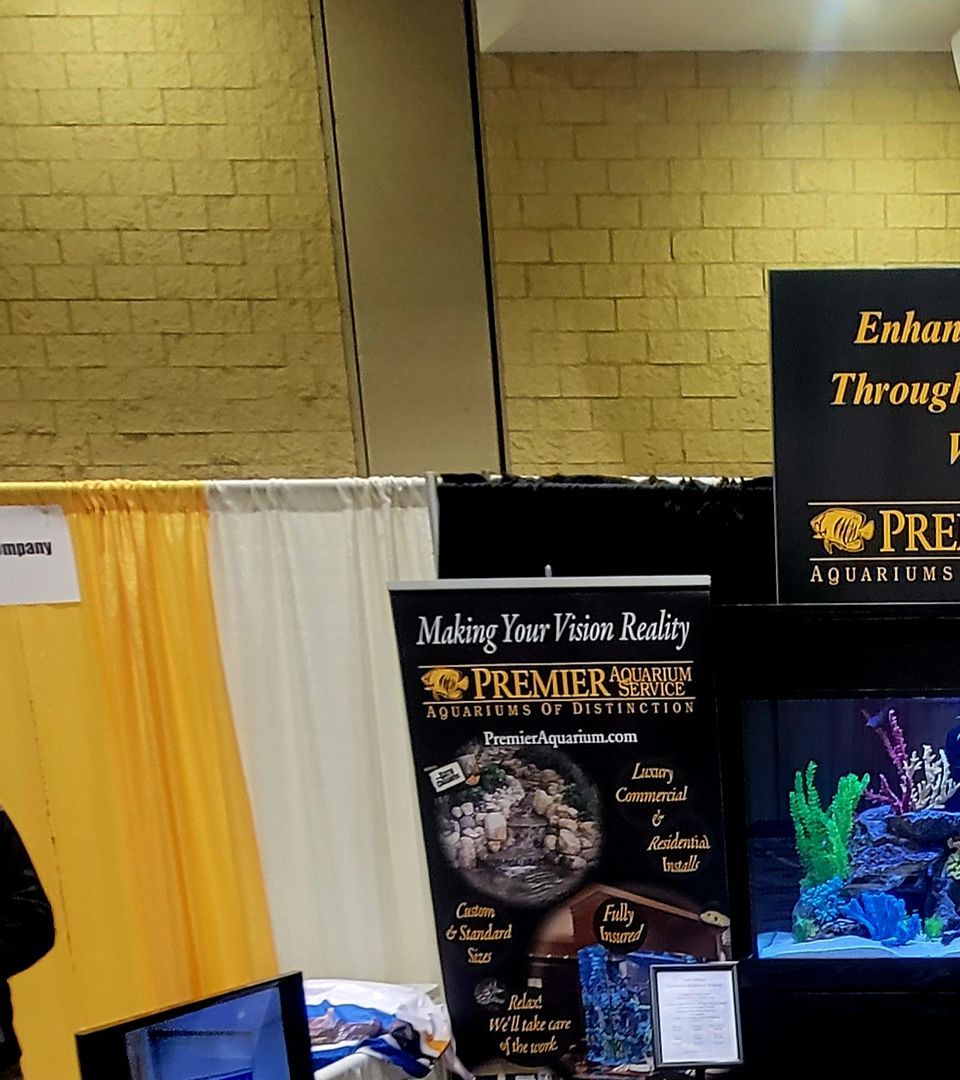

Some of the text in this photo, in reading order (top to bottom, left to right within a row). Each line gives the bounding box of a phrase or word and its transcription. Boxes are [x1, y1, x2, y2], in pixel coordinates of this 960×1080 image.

[0, 541, 52, 556] mpany
[810, 566, 953, 585] AQUARIUMS
[416, 610, 690, 653] Making Your Vision Reality
[472, 666, 692, 699] PREMIER AQUARIUM
[618, 682, 685, 697] SERVICE
[426, 701, 694, 720] AQUARIUMS OF DISTINCTION
[483, 730, 638, 748] PremierAquarium.com
[632, 763, 674, 784] Luxury
[616, 786, 688, 803] Commercial
[652, 810, 665, 827] &
[647, 832, 711, 851] Residential
[662, 855, 700, 873] Installs
[456, 902, 496, 919] Custom
[603, 903, 635, 928] Fully
[445, 923, 512, 941] & Standard
[600, 923, 644, 944] Insured
[467, 947, 492, 964] Sizes
[508, 992, 542, 1011] Relax!
[489, 1014, 572, 1032] We'll take care
[500, 1035, 559, 1056] of the work
